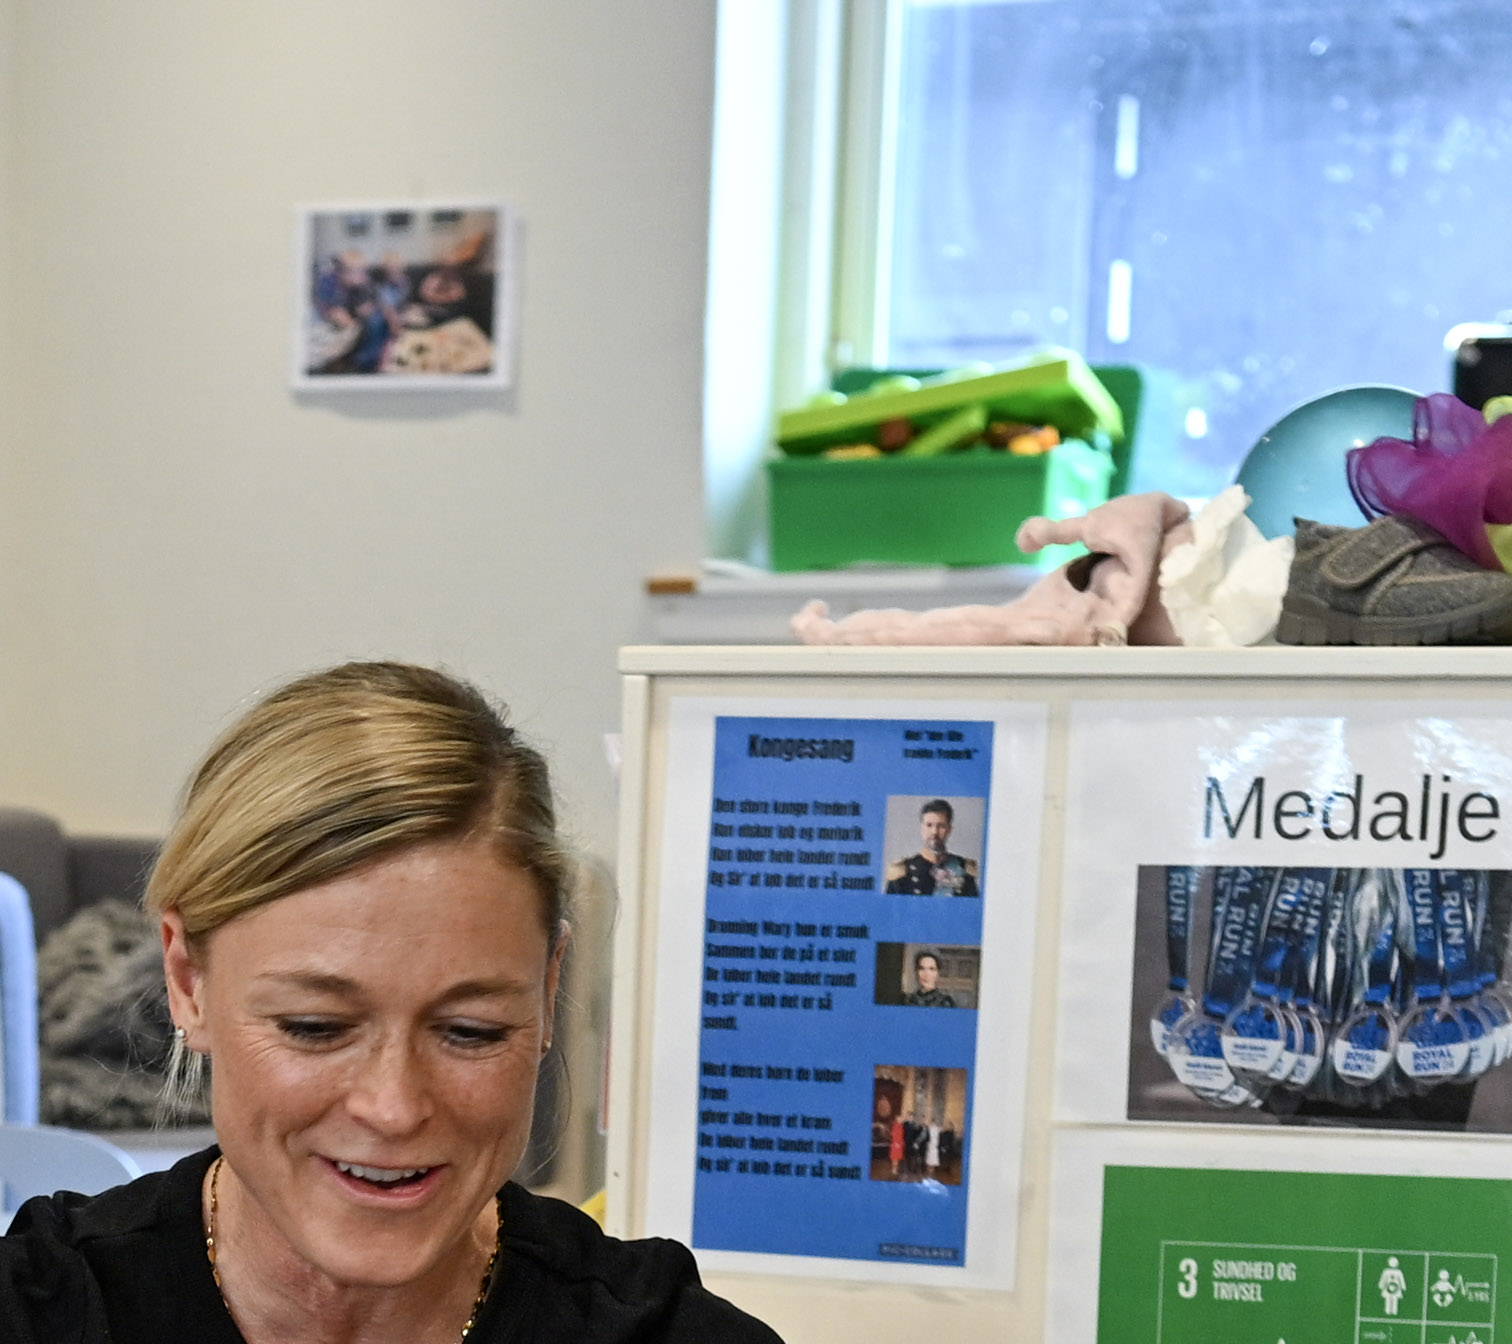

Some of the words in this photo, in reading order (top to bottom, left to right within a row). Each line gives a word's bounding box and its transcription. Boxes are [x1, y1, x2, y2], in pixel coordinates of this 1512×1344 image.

[748, 734, 854, 762] Kongesang
[1203, 774, 1500, 860] Medalje
[1177, 1257, 1199, 1299] 3
[1212, 1259, 1275, 1281] SUNDHED
[1276, 1262, 1298, 1281] OG
[1212, 1281, 1264, 1302] TRIVSEL
